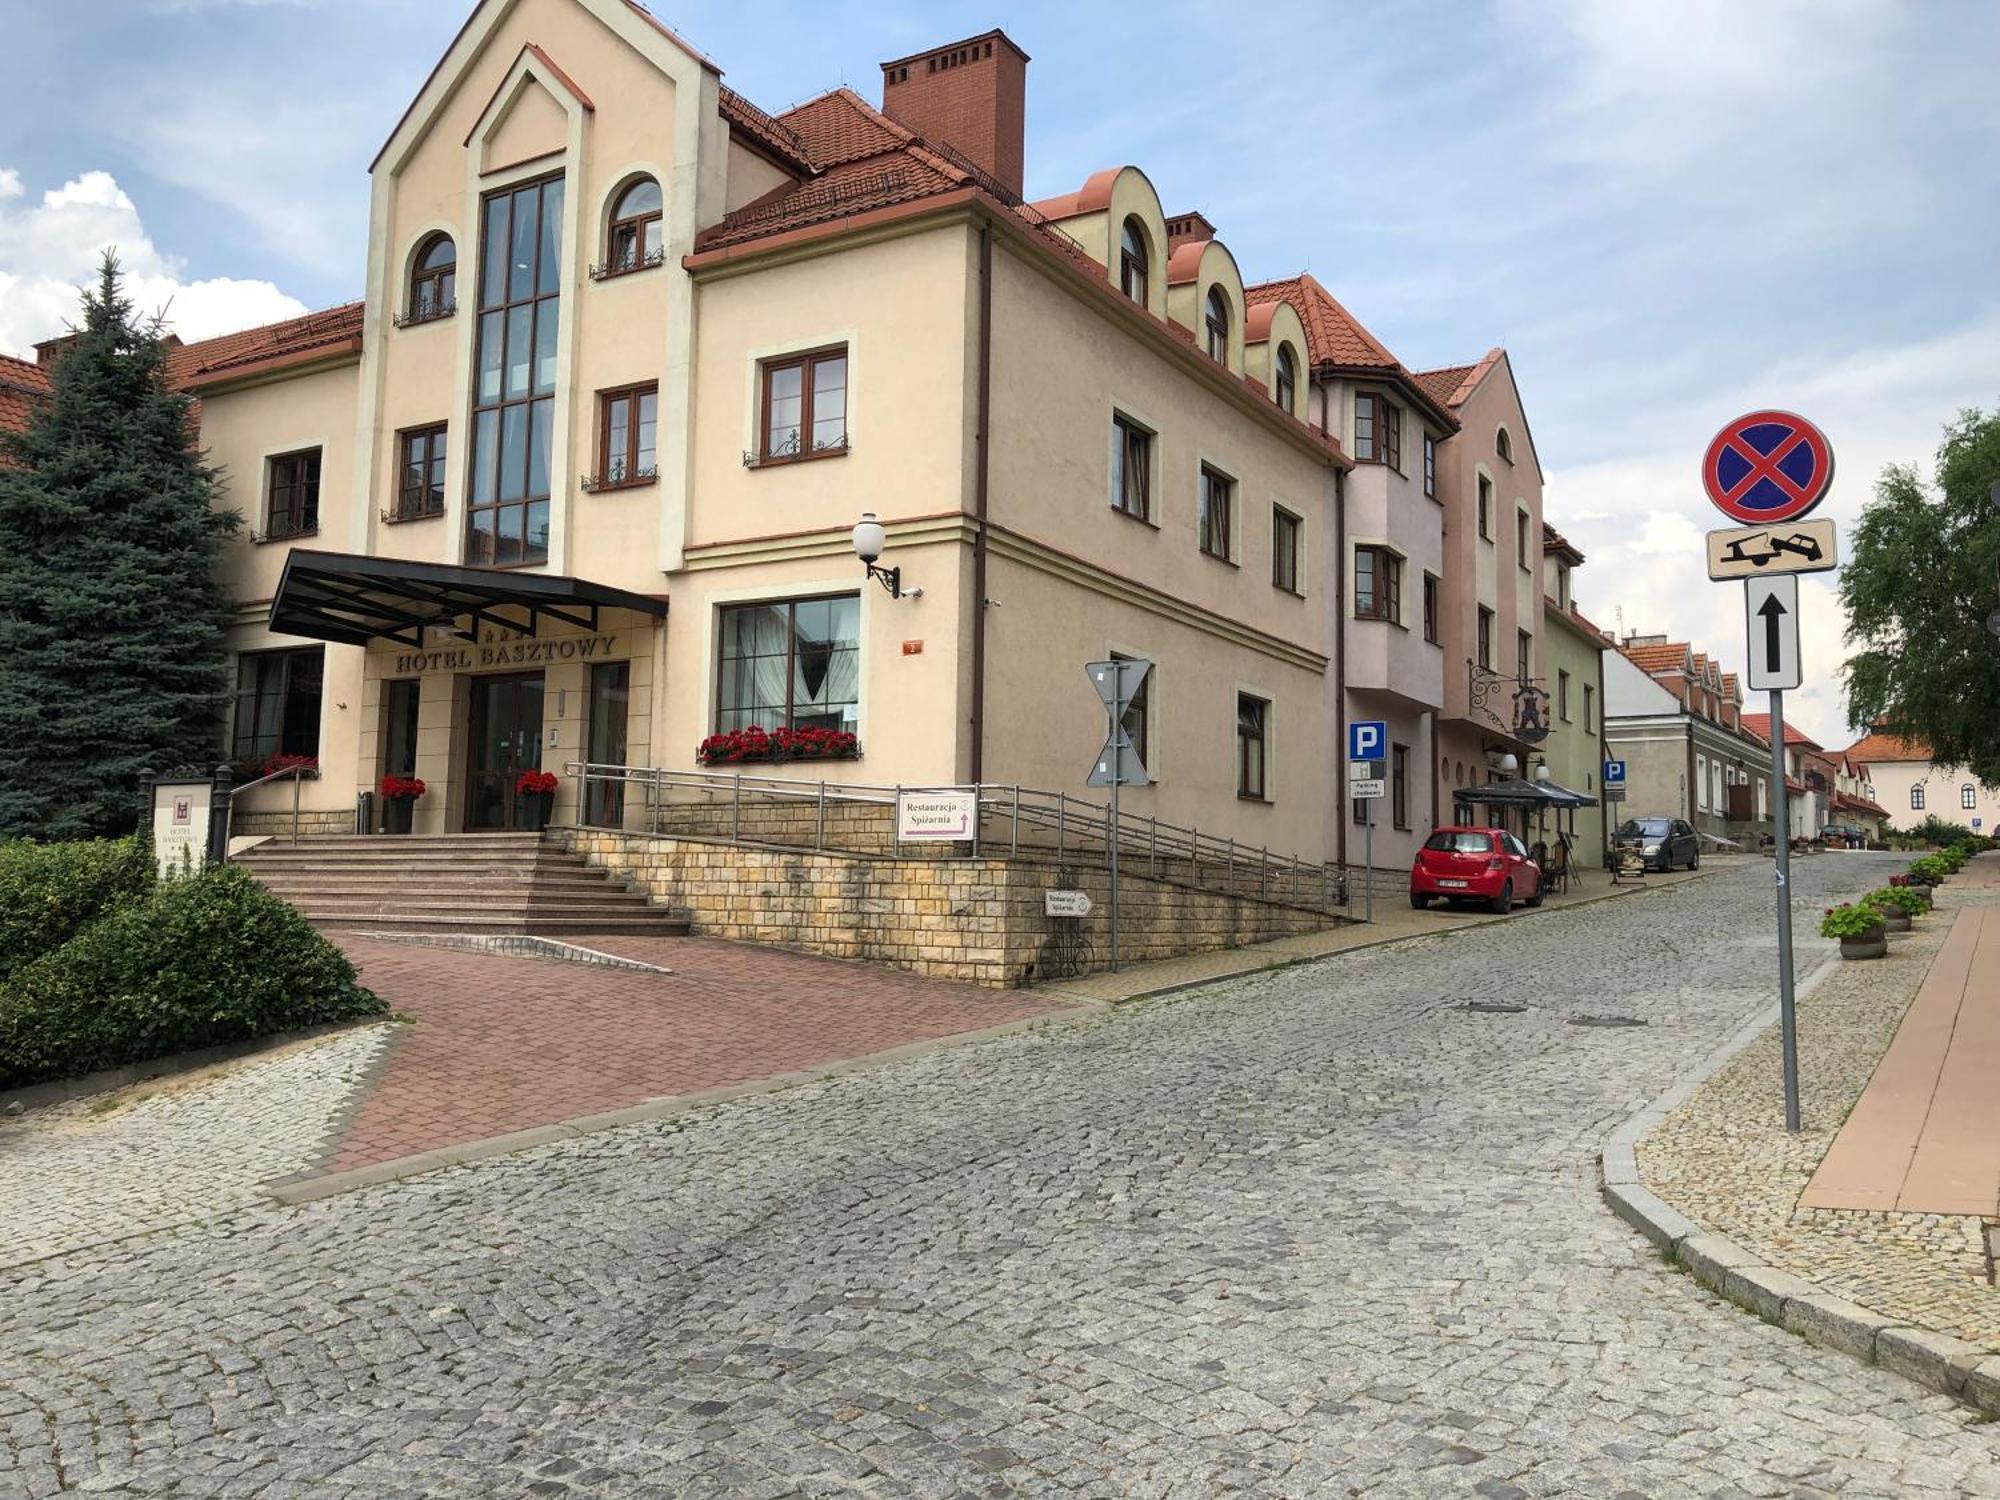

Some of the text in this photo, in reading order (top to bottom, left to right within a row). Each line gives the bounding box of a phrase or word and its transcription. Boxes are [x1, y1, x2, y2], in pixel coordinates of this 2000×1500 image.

[396, 636, 616, 673] HOTEL BASZTOWY
[1357, 726, 1378, 756] P
[1608, 763, 1621, 779] P
[907, 802, 957, 813] Restauracja
